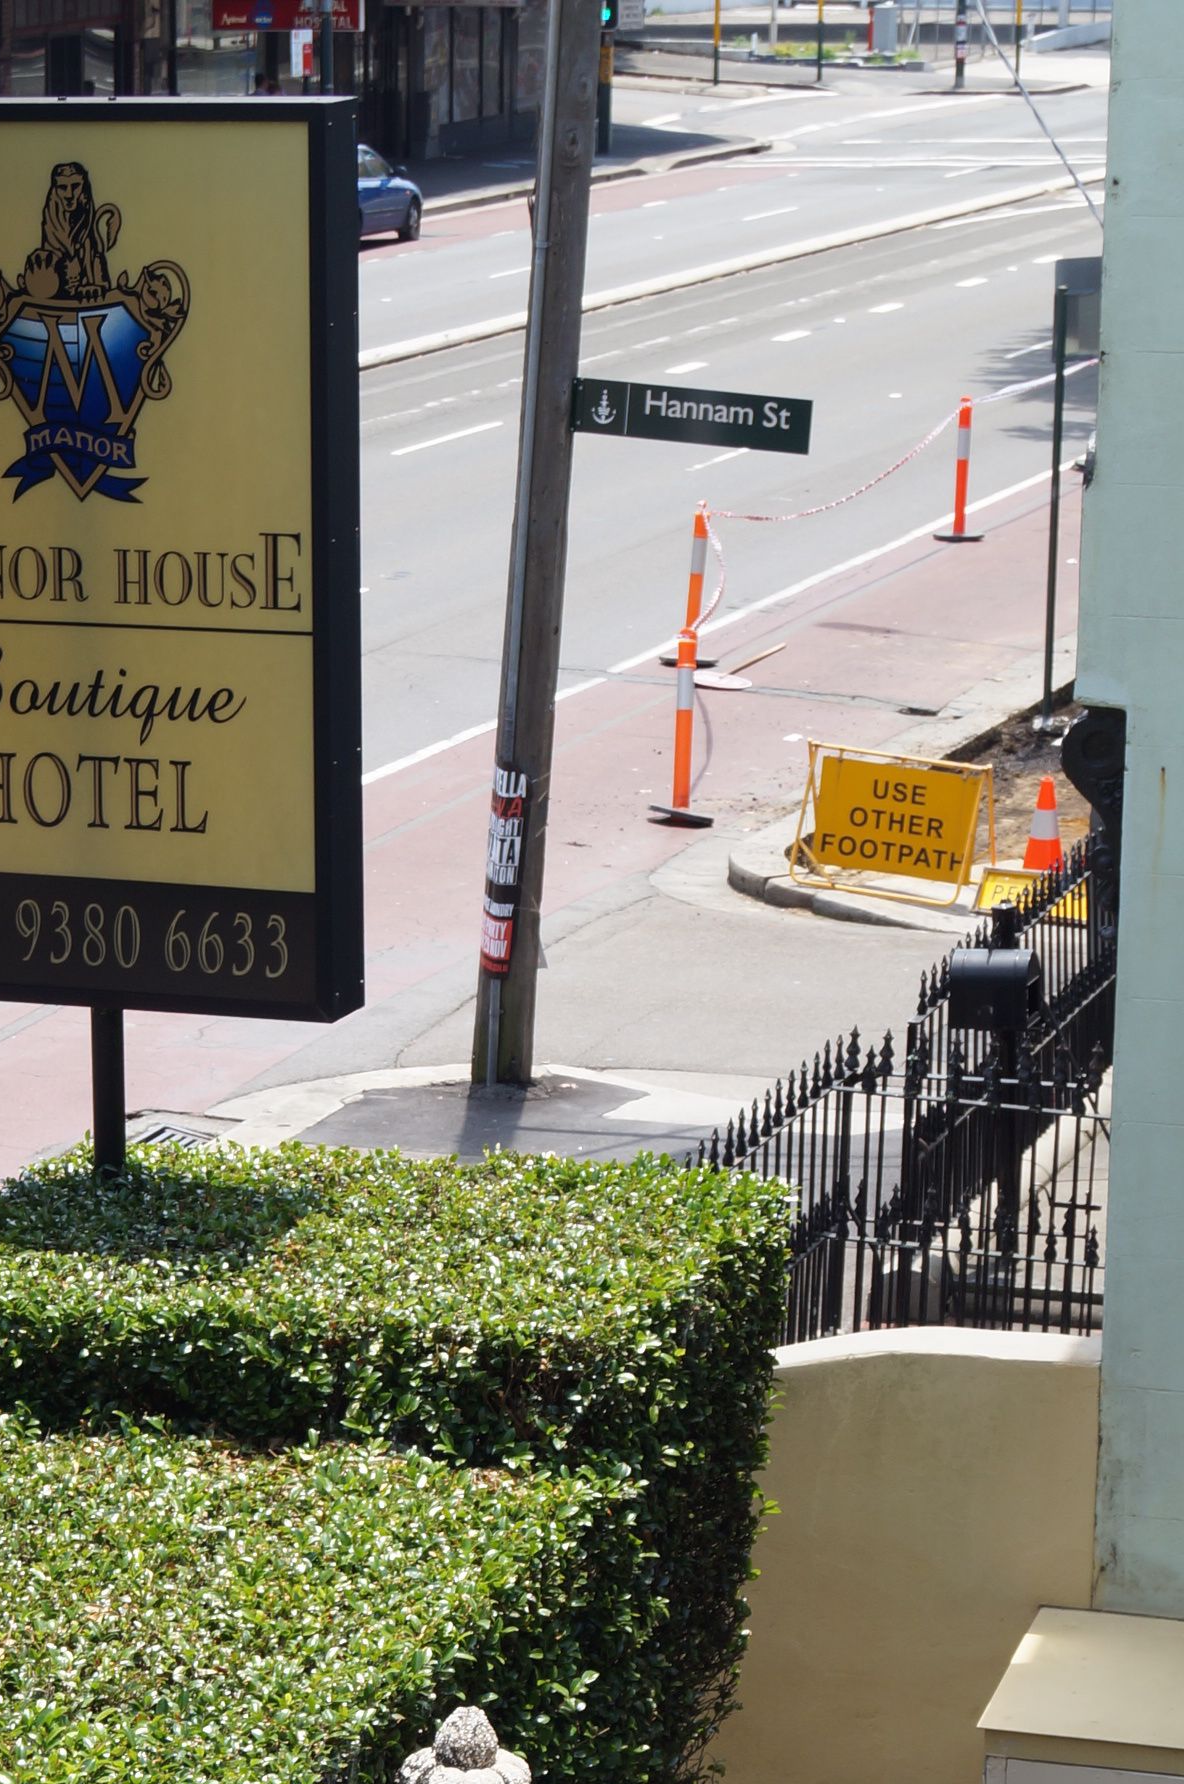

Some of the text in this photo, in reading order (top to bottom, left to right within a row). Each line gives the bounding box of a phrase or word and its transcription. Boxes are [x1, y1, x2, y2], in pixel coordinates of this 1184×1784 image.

[644, 390, 790, 429] Hannam St
[30, 427, 132, 465] MANOR
[113, 532, 302, 613] HOUSE
[873, 779, 927, 806] USE
[849, 807, 943, 839] OTHER
[820, 833, 964, 872] FOOTPATH
[16, 899, 141, 969] 9380
[164, 909, 289, 979] 6633
